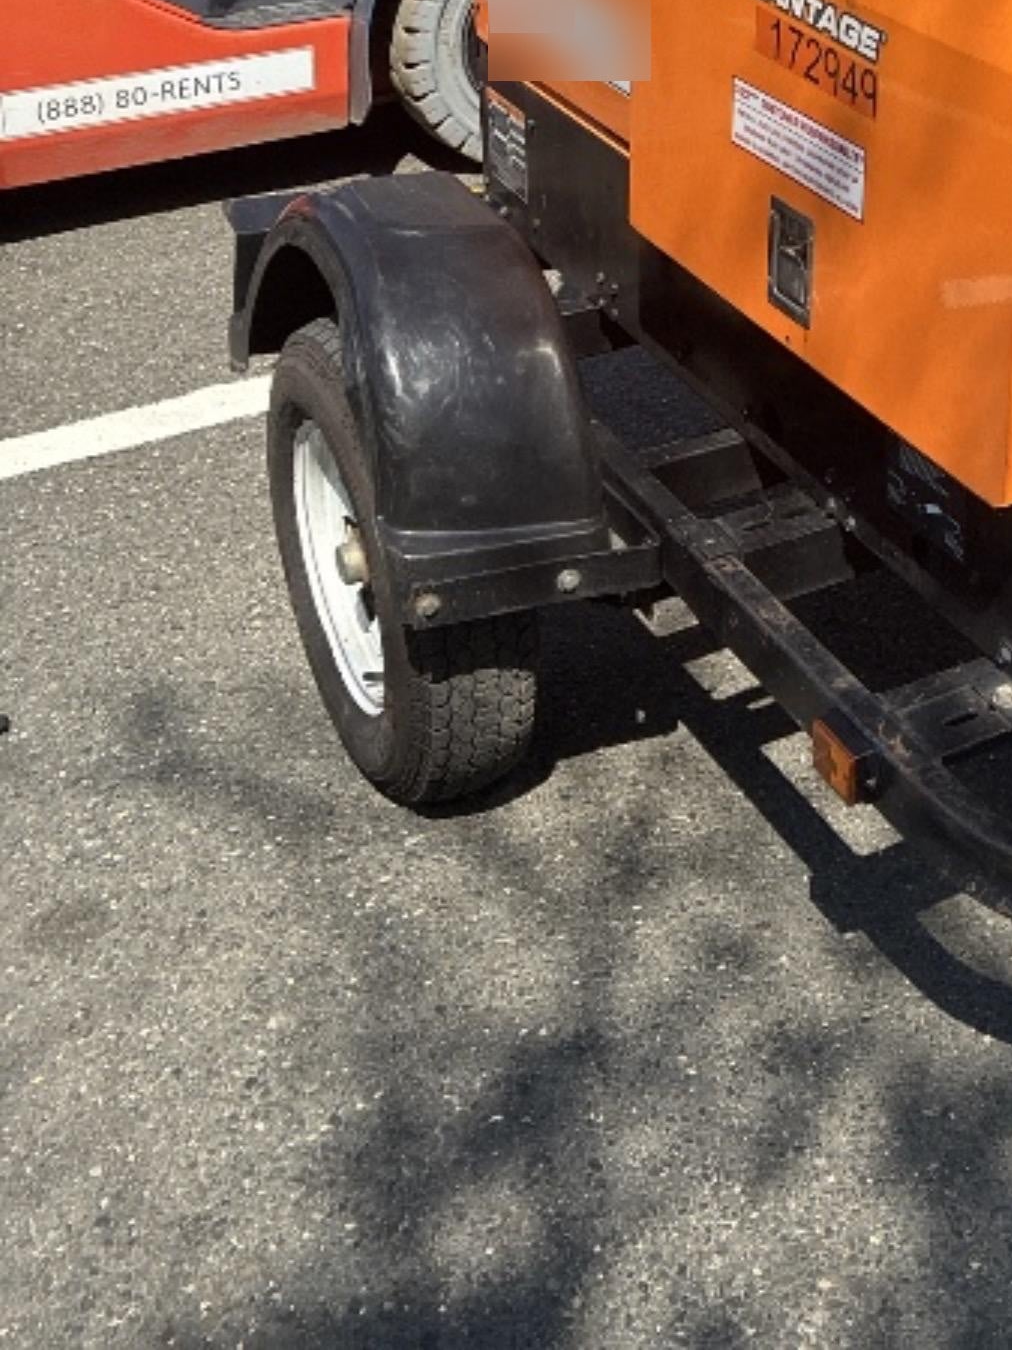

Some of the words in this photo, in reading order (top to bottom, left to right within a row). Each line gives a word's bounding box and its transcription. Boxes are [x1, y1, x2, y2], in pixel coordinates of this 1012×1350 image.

[38, 92, 105, 124] (888)
[115, 71, 242, 109] 80-RENTS
[769, 18, 878, 120] 172949
